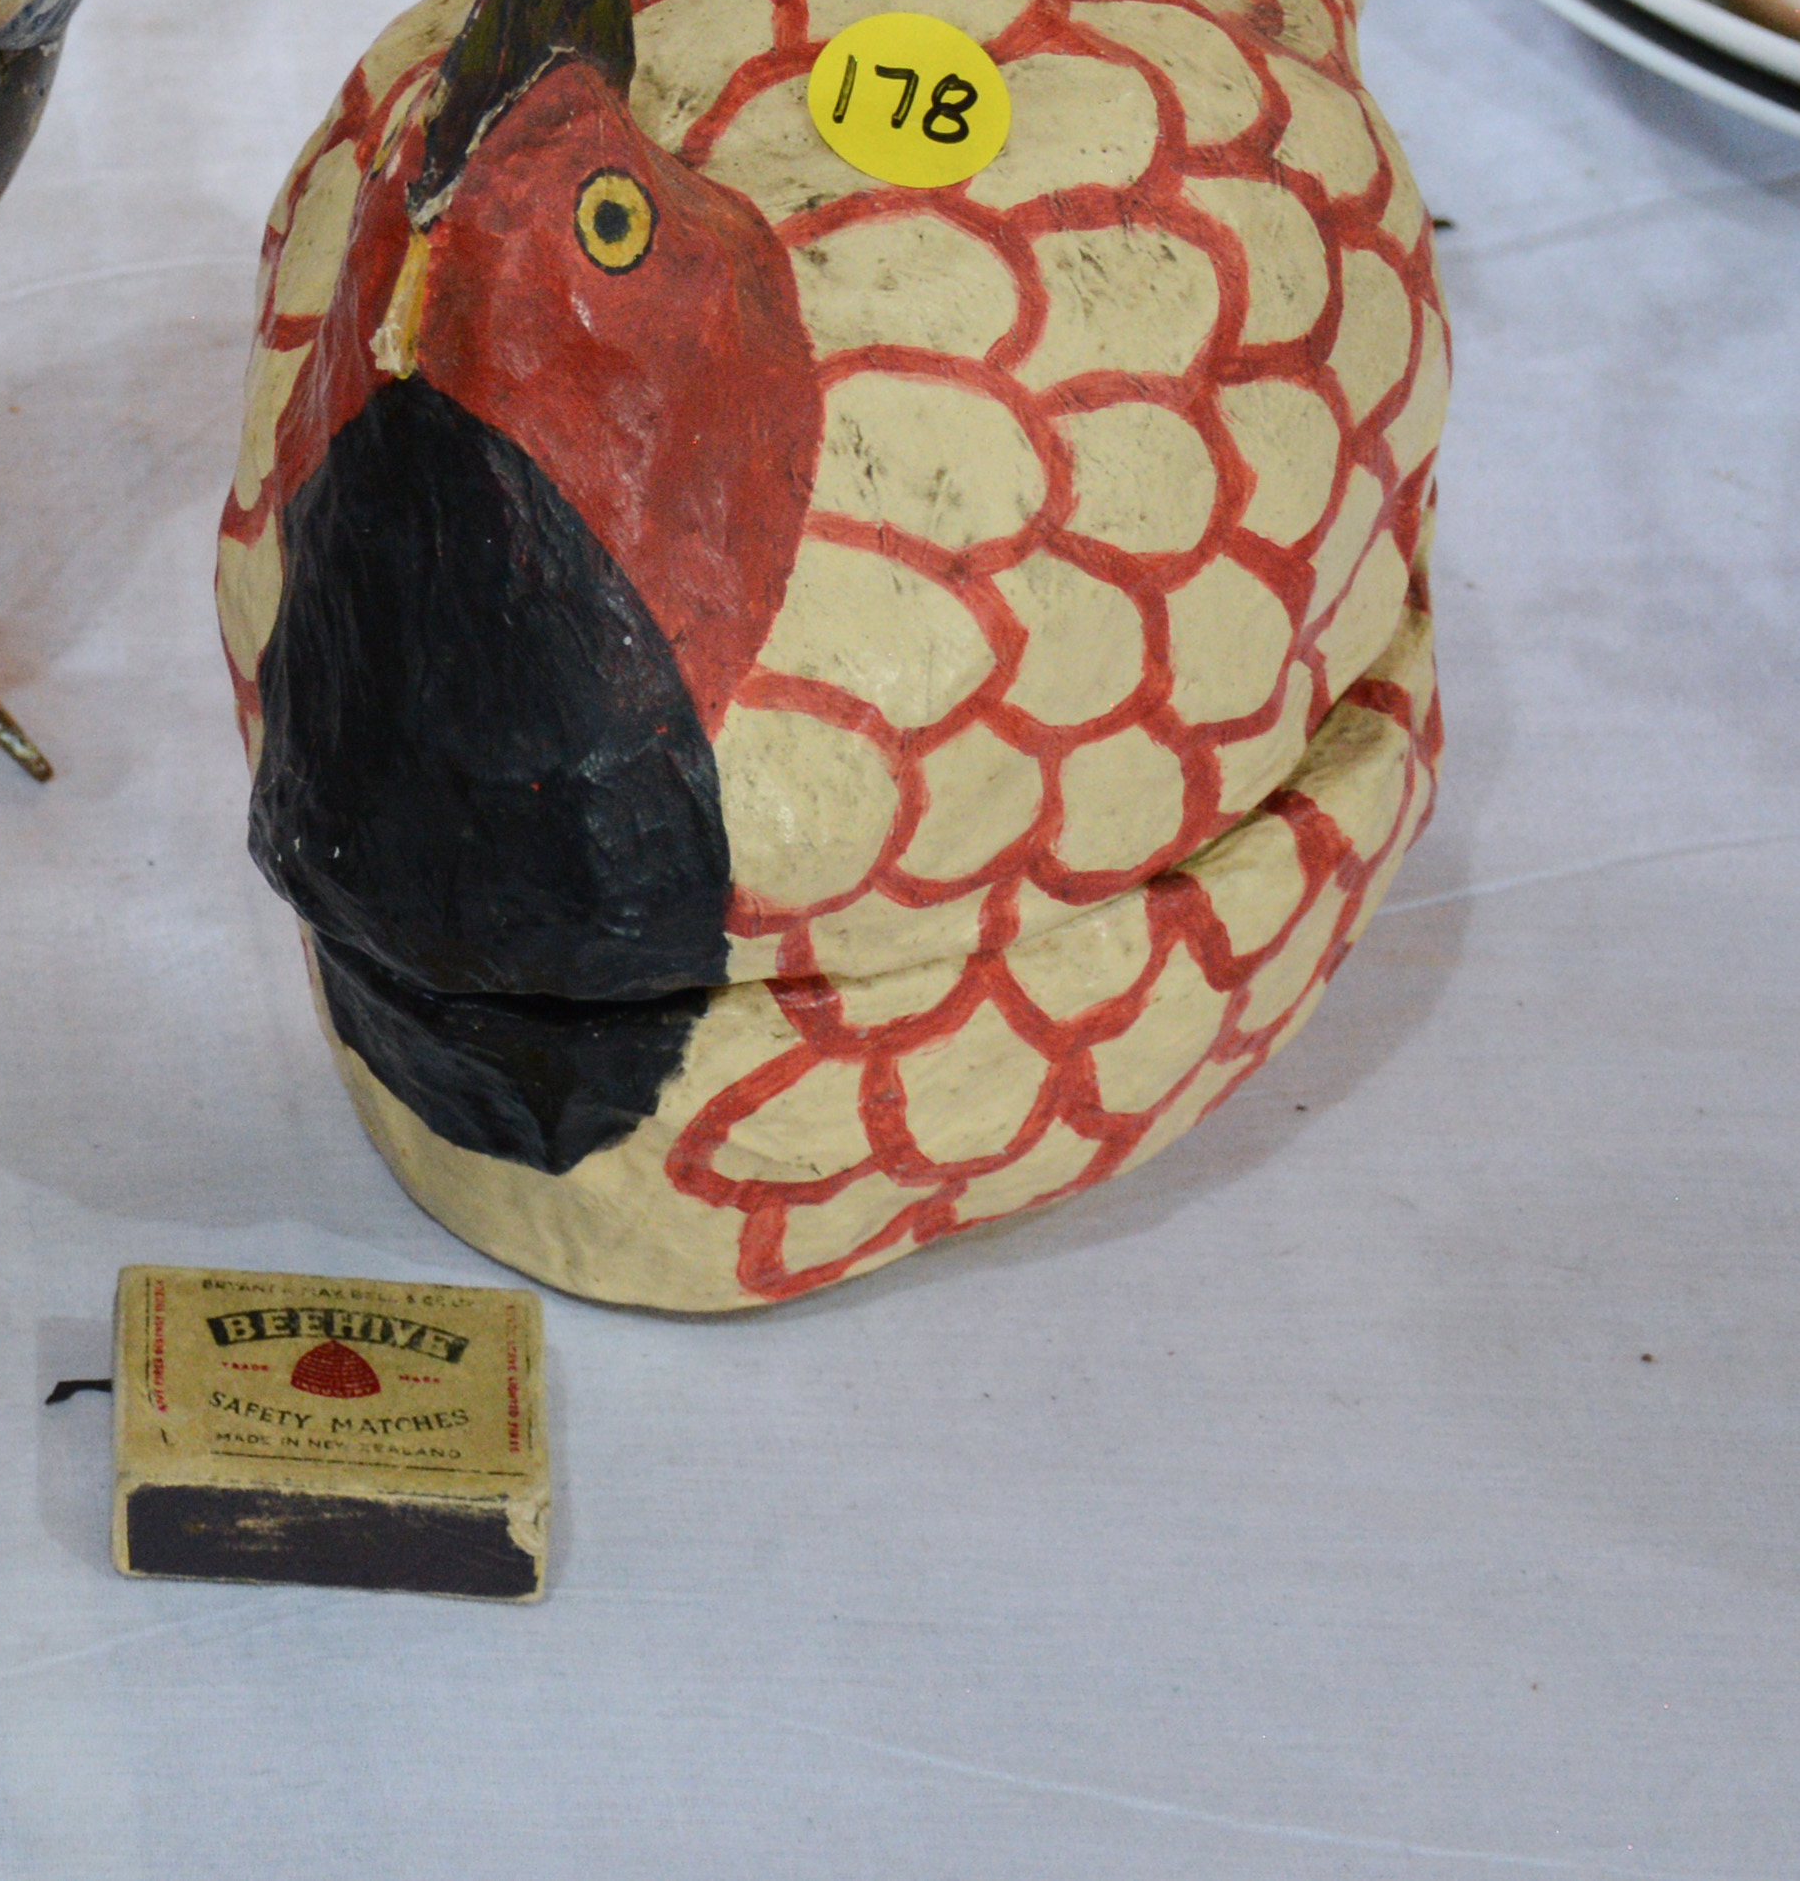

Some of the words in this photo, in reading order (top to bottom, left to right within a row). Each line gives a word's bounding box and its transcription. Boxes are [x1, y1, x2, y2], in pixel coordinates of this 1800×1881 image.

[832, 53, 979, 145] 178
[219, 1309, 454, 1361] BEEHIVE
[221, 1361, 270, 1372] TRADE
[398, 1374, 441, 1384] MARK
[208, 1390, 312, 1430] SAFETY
[331, 1408, 470, 1435] MATCHES
[215, 1432, 270, 1446] MADE
[281, 1436, 301, 1448] IN
[360, 1441, 463, 1460] ZEALAND
